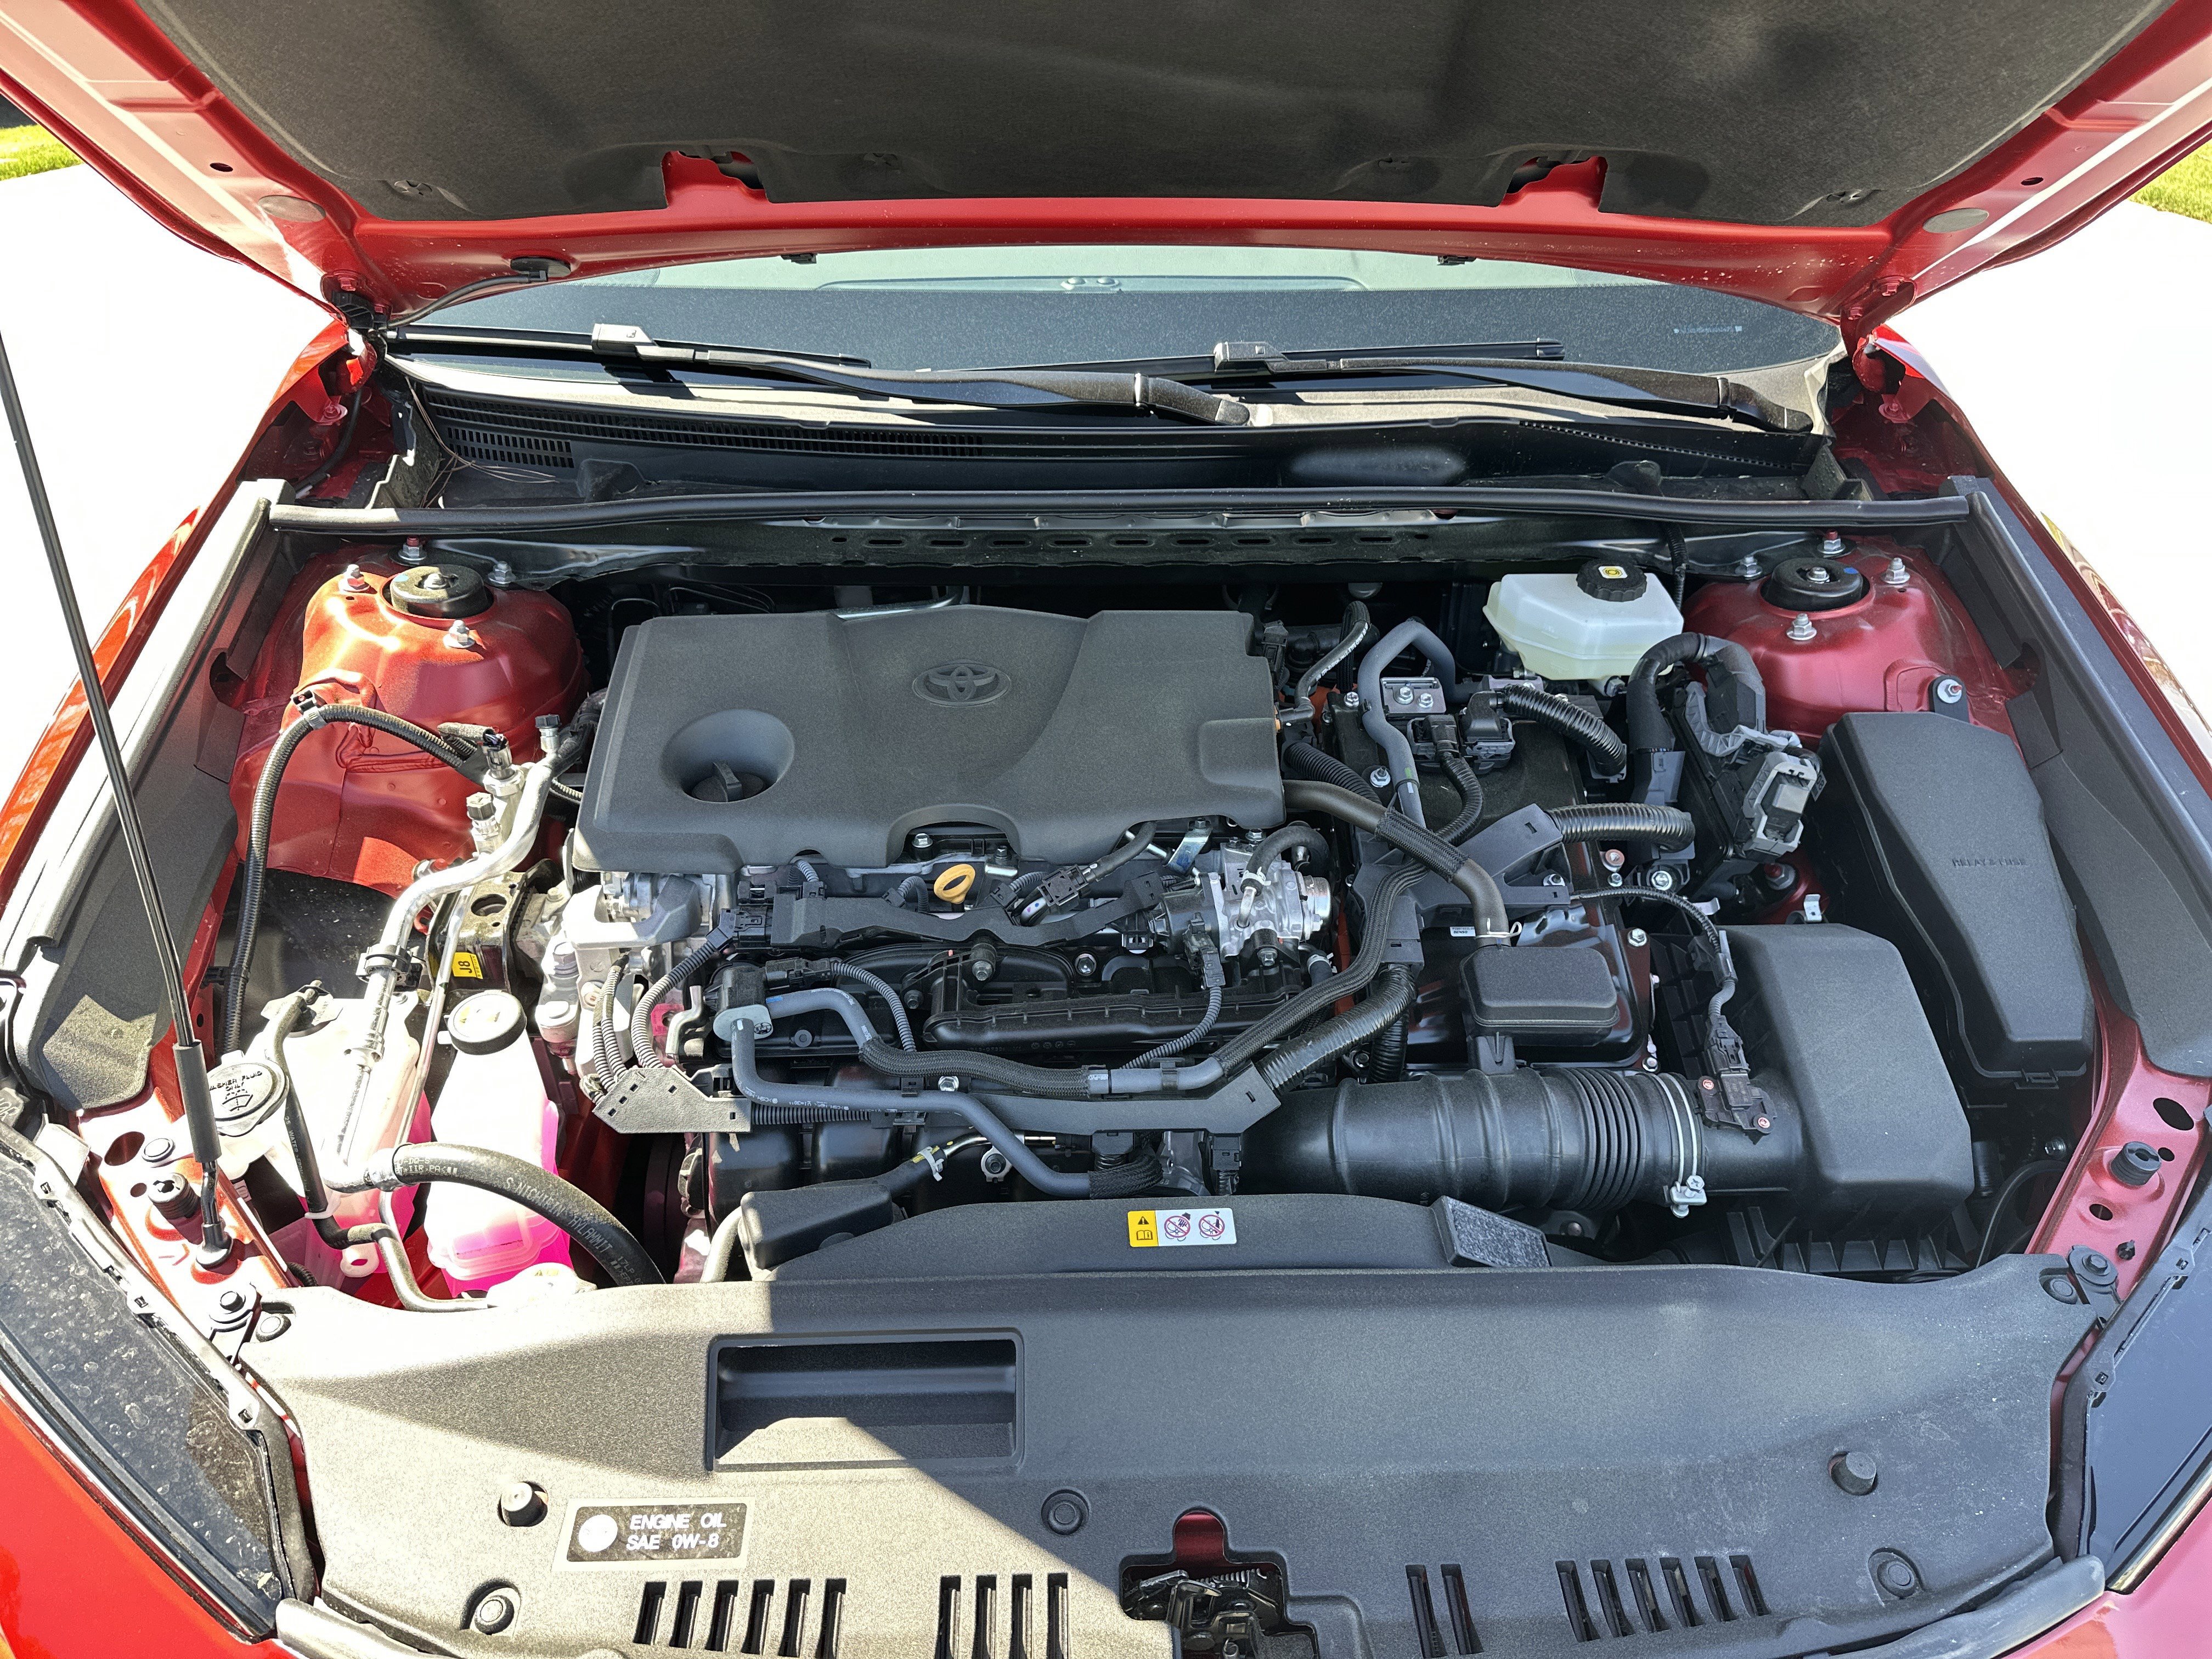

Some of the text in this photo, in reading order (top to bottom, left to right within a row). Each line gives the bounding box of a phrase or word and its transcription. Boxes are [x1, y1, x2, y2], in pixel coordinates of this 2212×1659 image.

[458, 960, 472, 974] J8
[284, 1115, 291, 1125] 25
[289, 1130, 299, 1153] WATER
[630, 1513, 727, 1530] ENGINE OIL
[626, 1533, 720, 1551] SAE 0W-8
